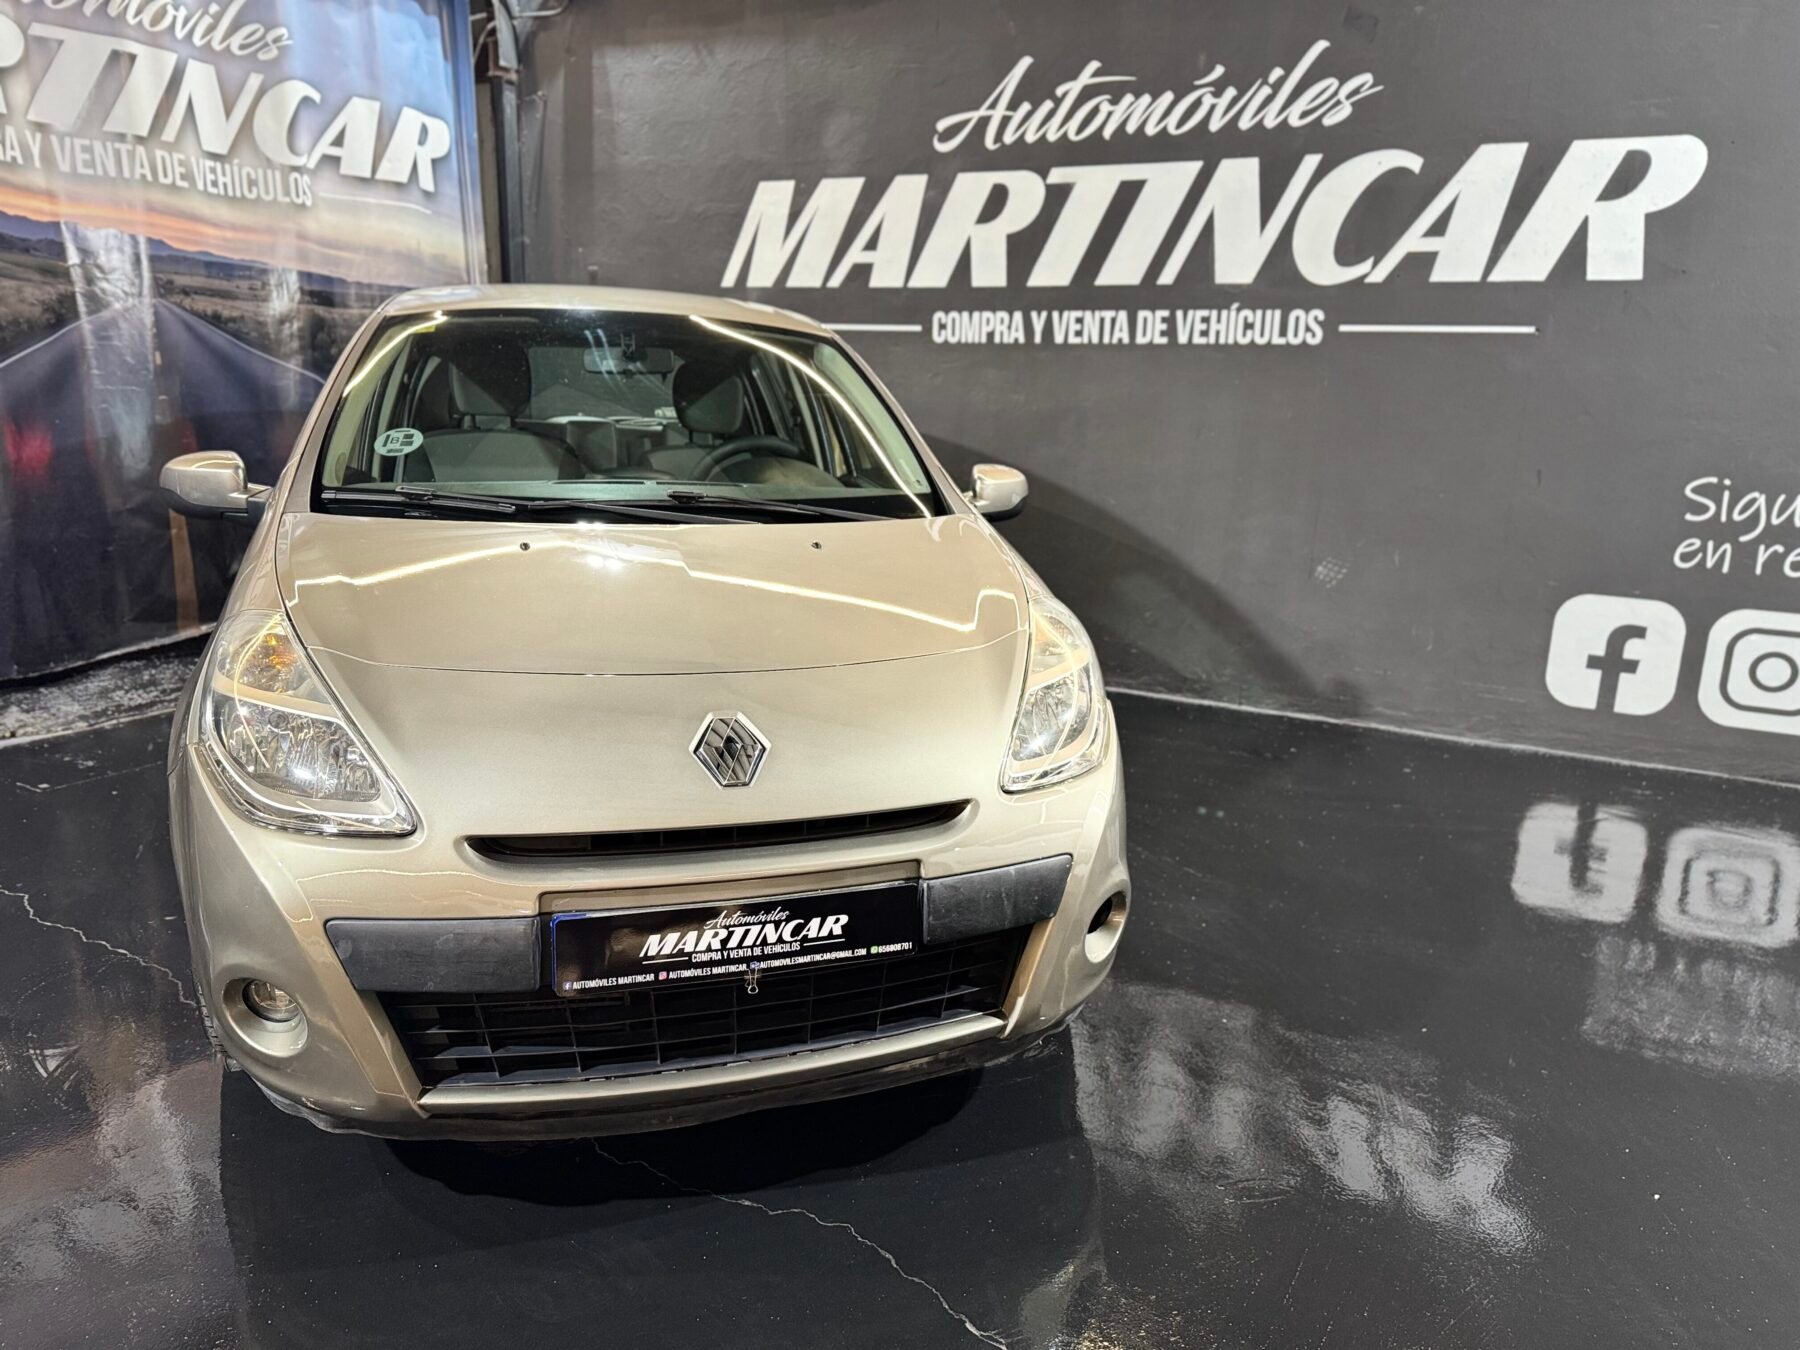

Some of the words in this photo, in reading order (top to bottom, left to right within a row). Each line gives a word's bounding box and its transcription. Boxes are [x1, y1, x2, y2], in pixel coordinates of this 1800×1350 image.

[932, 39, 1384, 153] Automóviles
[25, 129, 41, 169] Y
[51, 135, 153, 183] VENTA
[157, 149, 188, 188] DE
[190, 156, 313, 208] VEHÍCULOS
[720, 134, 1708, 289] MARTINCAR
[931, 310, 1025, 344] COMPRA
[1030, 310, 1047, 344] Y
[1051, 310, 1130, 344] VENTA
[1135, 310, 1169, 344] DE
[1175, 303, 1325, 346] VEHÍCULOS
[1673, 537, 1732, 574] en
[639, 914, 849, 958] MARTINCAR
[703, 906, 790, 930] Automóviles
[691, 949, 722, 963] COMPRA
[723, 950, 729, 959] Y
[729, 948, 752, 959] VENTA
[753, 946, 763, 956] DE
[763, 941, 801, 955] VEHÍCULOS
[572, 978, 617, 990] AUTOMÓVILES
[617, 973, 655, 985] MARTINCAR
